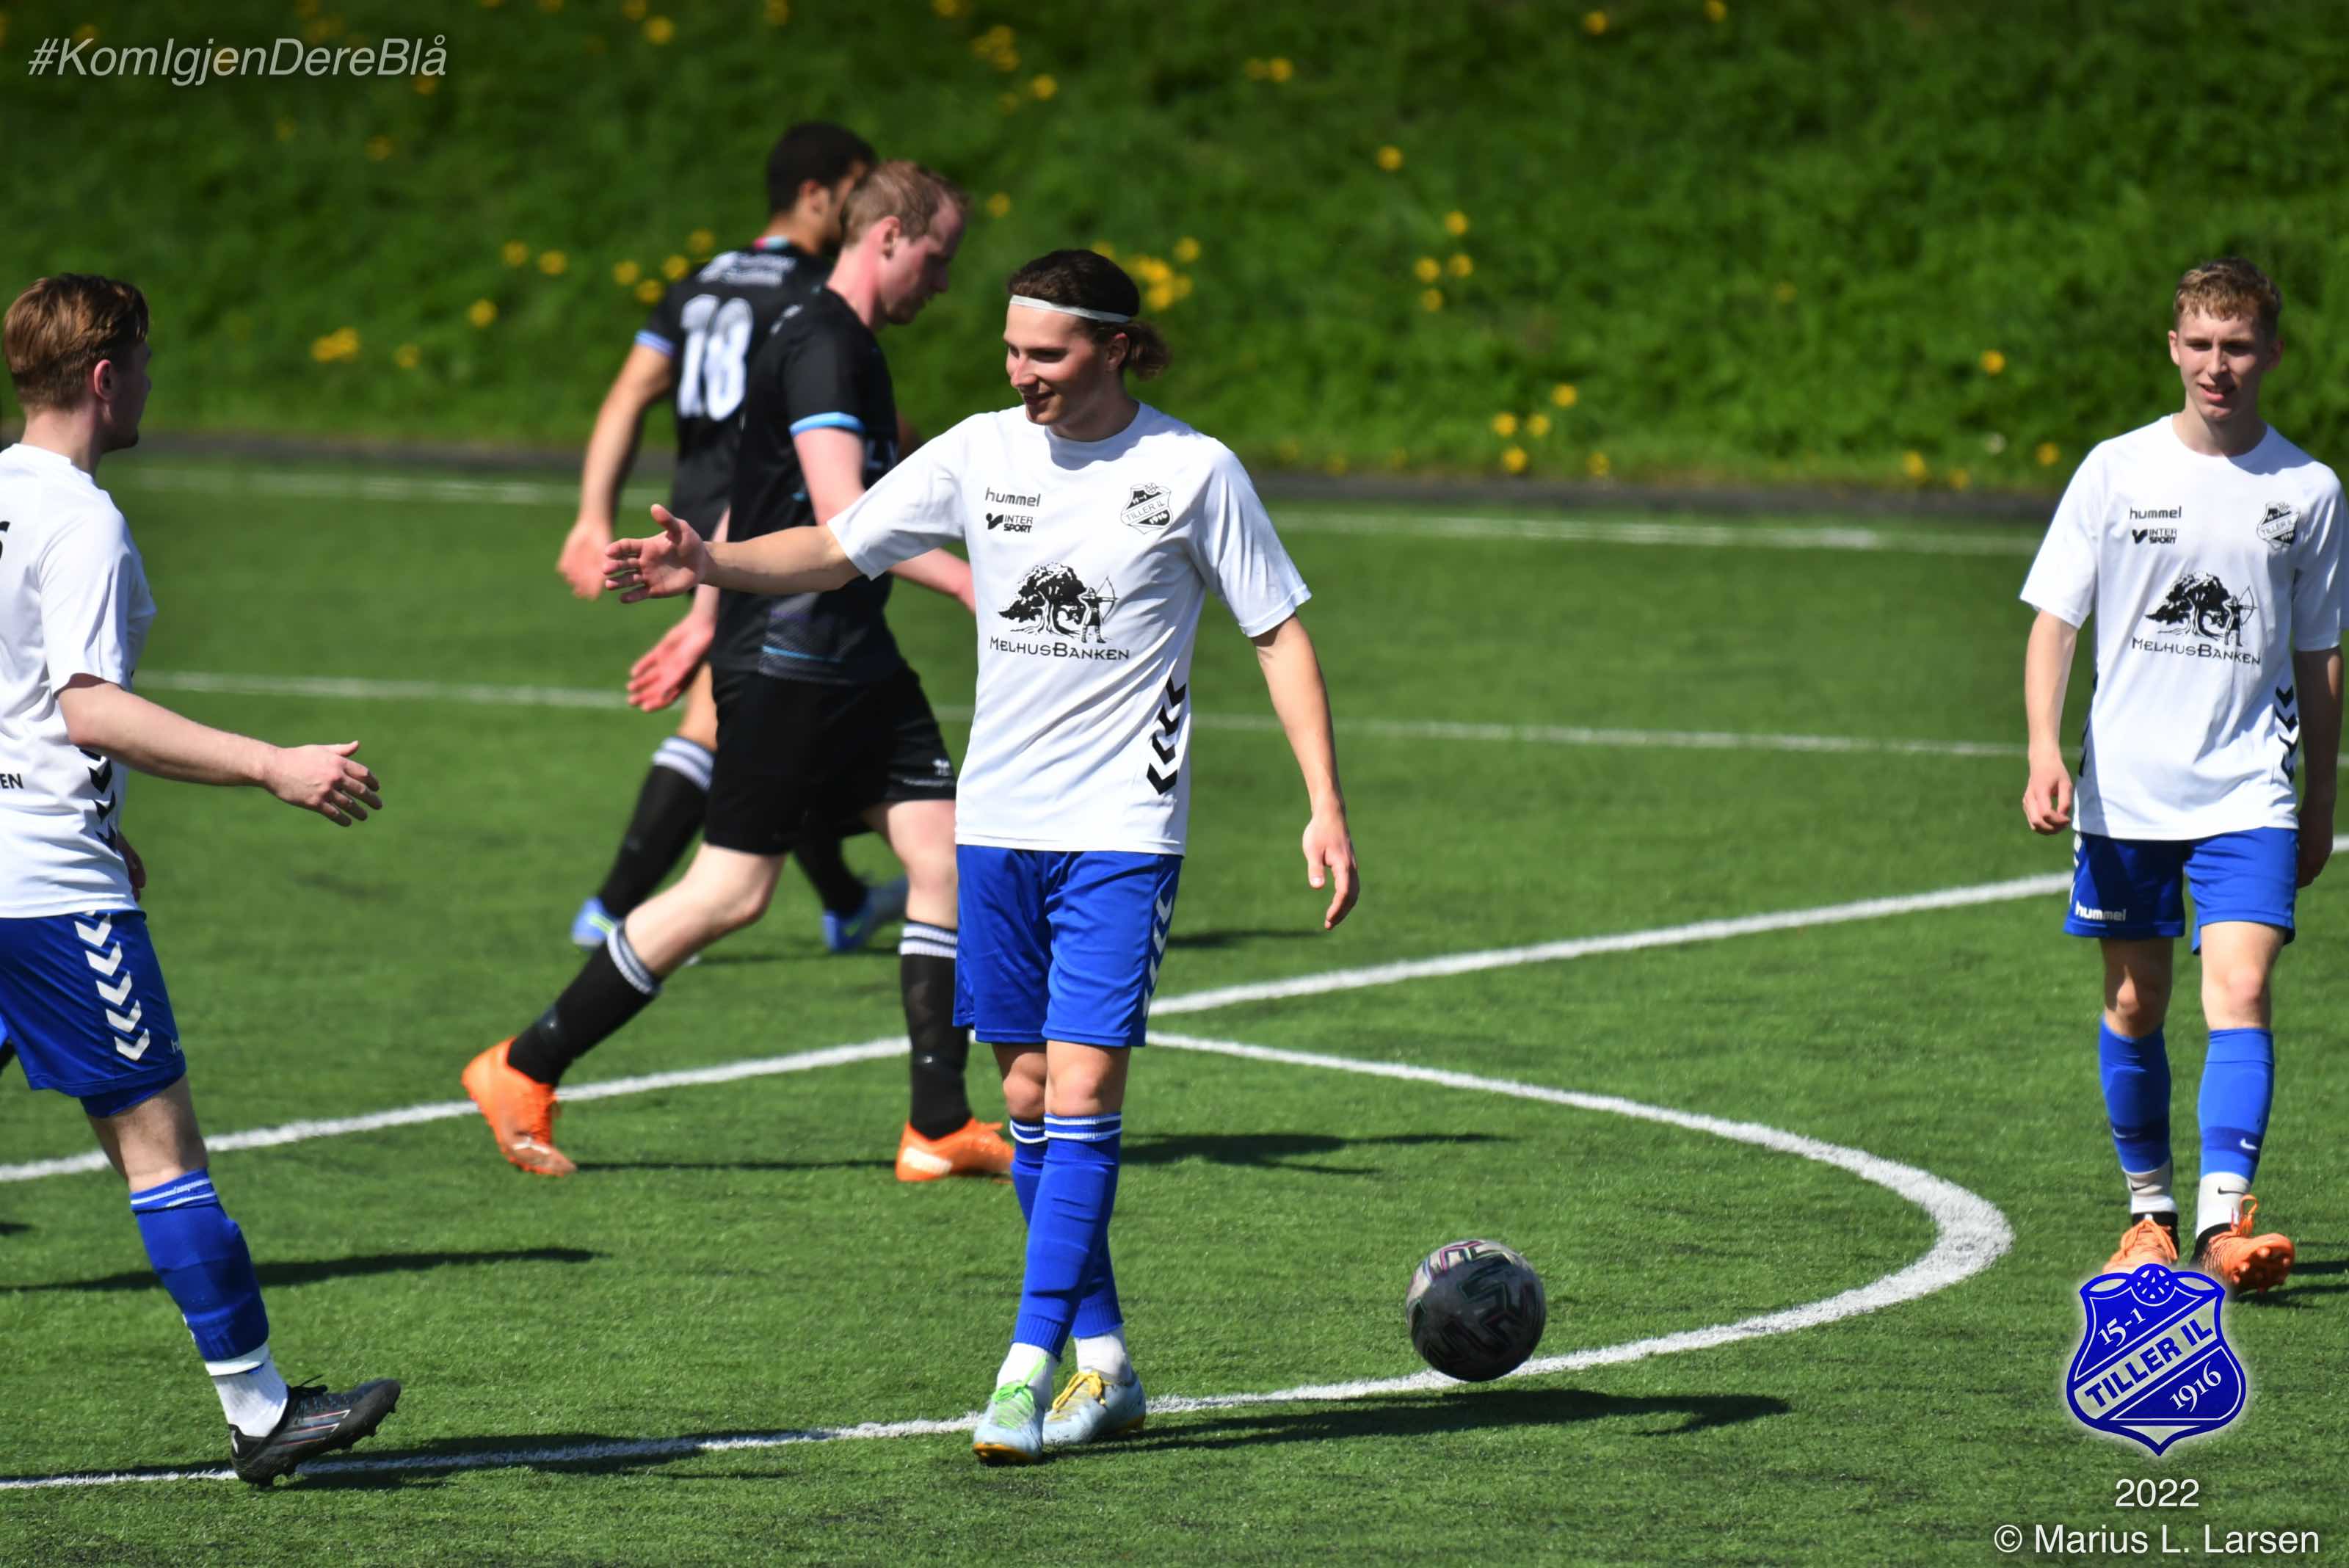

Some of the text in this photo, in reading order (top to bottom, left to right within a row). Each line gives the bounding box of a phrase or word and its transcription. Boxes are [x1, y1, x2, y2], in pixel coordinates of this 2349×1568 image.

[677, 294, 754, 421] 18
[985, 487, 1041, 507] hummel
[1004, 514, 1034, 524] INTER
[1126, 504, 1157, 521] TILLER
[2130, 505, 2182, 520] hummel
[1003, 523, 1032, 533] SPORT
[2149, 529, 2178, 537] INTER
[0, 773, 24, 789] EN
[2075, 901, 2127, 921] hummel
